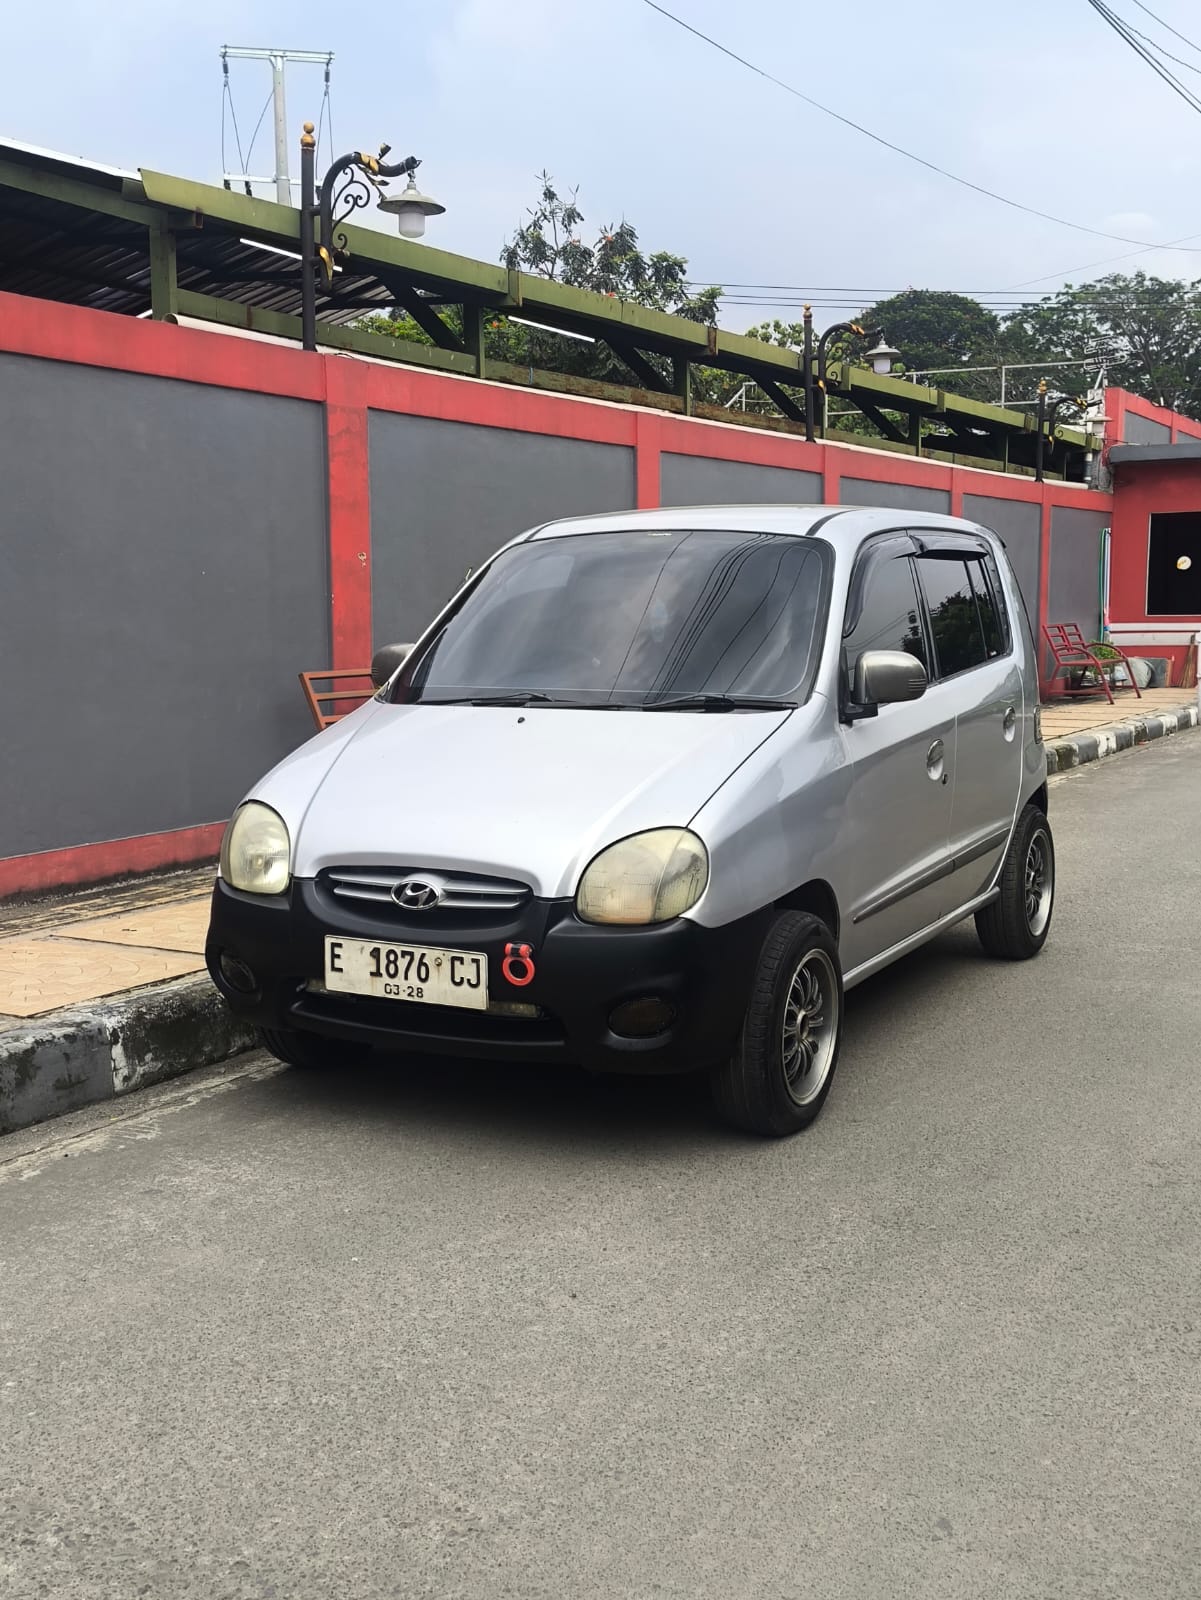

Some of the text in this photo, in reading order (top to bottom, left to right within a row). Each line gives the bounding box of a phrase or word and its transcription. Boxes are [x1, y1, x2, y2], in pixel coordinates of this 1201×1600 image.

[330, 942, 481, 989] E 1876 CJ
